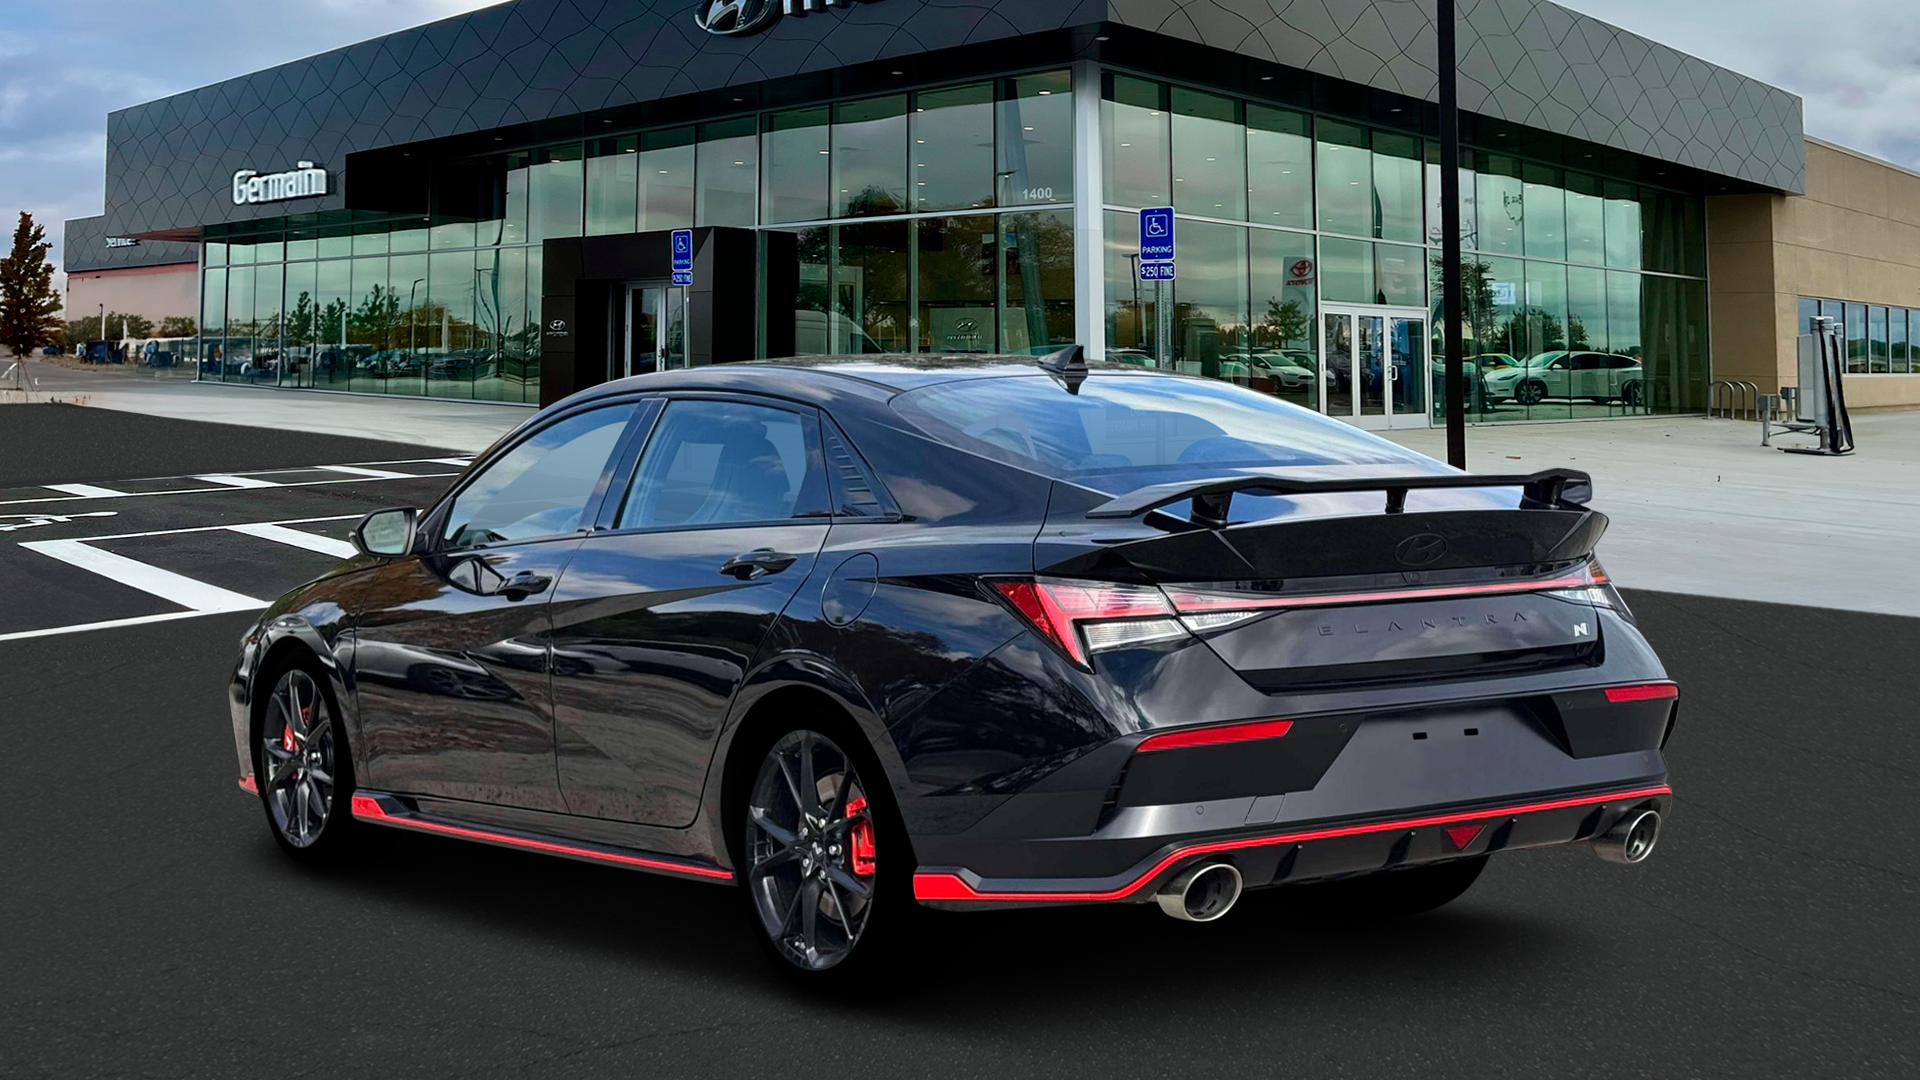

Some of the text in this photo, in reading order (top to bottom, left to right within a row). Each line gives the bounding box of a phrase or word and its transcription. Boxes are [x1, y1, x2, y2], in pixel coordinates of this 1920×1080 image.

[233, 161, 327, 205] Germain
[1022, 187, 1052, 200] 1400
[1142, 245, 1172, 254] PARKING
[1141, 266, 1173, 278] $250 FINE
[1317, 611, 1589, 637] ELANTRA N
